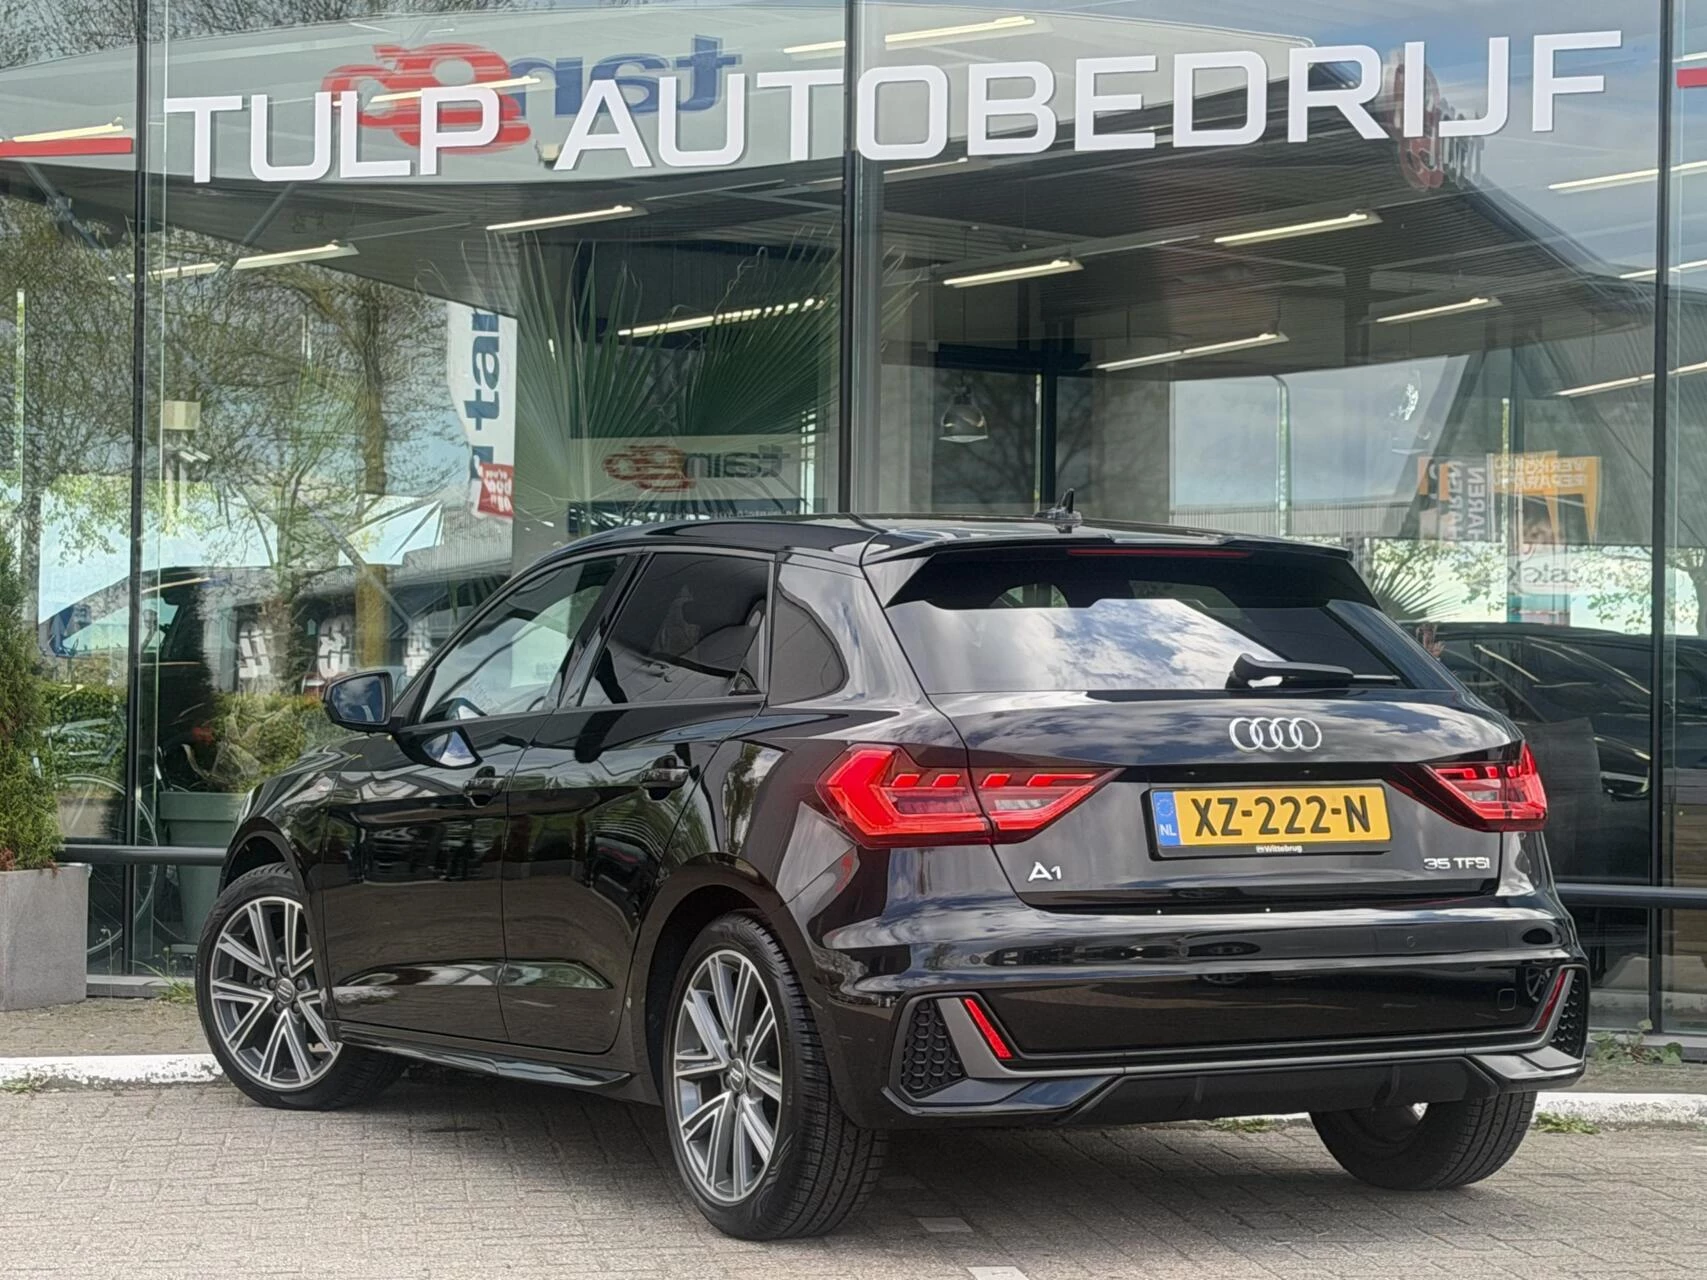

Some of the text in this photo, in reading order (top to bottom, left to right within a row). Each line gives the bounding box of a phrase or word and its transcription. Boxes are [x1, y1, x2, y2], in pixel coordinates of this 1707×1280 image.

[164, 86, 501, 183] TULP
[554, 30, 1621, 171] AUTOBEDRIJF
[1190, 795, 1371, 837] XZ-222-N
[1159, 823, 1177, 836] NL
[1028, 861, 1062, 882] A1
[1423, 856, 1491, 870] 35 TFSI
